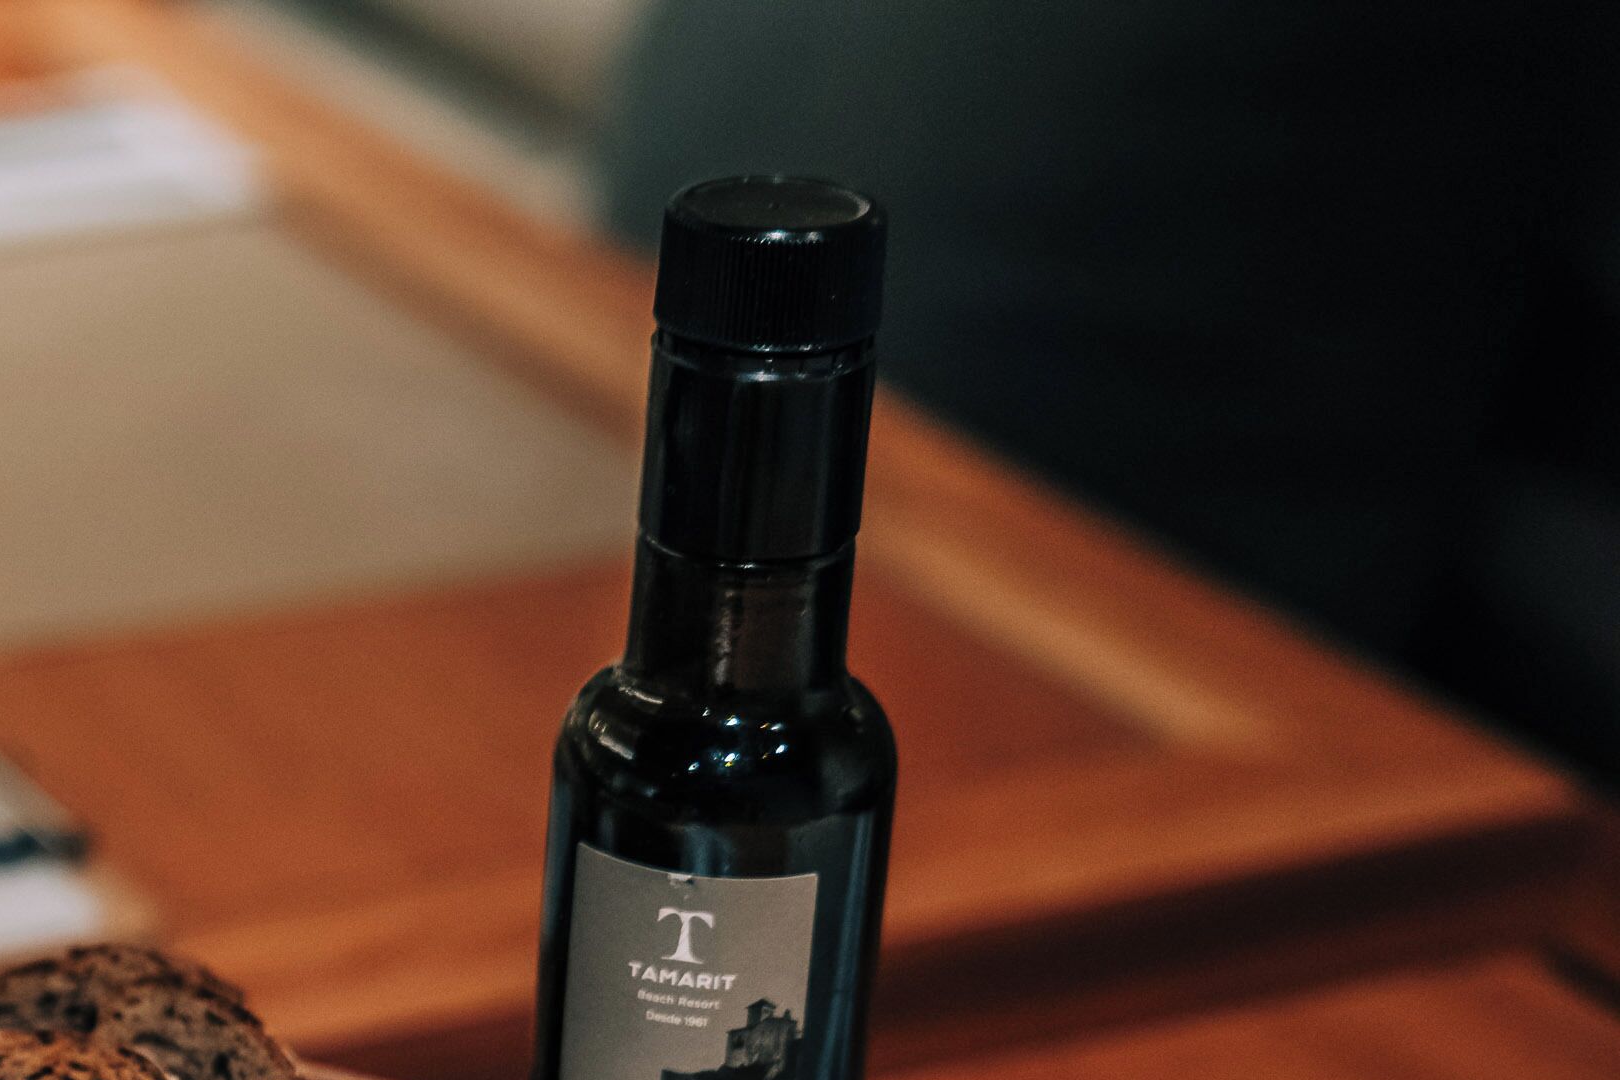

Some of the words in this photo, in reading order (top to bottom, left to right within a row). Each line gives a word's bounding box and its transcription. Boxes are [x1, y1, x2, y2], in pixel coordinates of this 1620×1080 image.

[657, 907, 714, 964] T
[629, 961, 737, 990] TAMARIT
[637, 989, 674, 1005] Beach
[678, 997, 720, 1010] Resort
[645, 1010, 681, 1025] Desde
